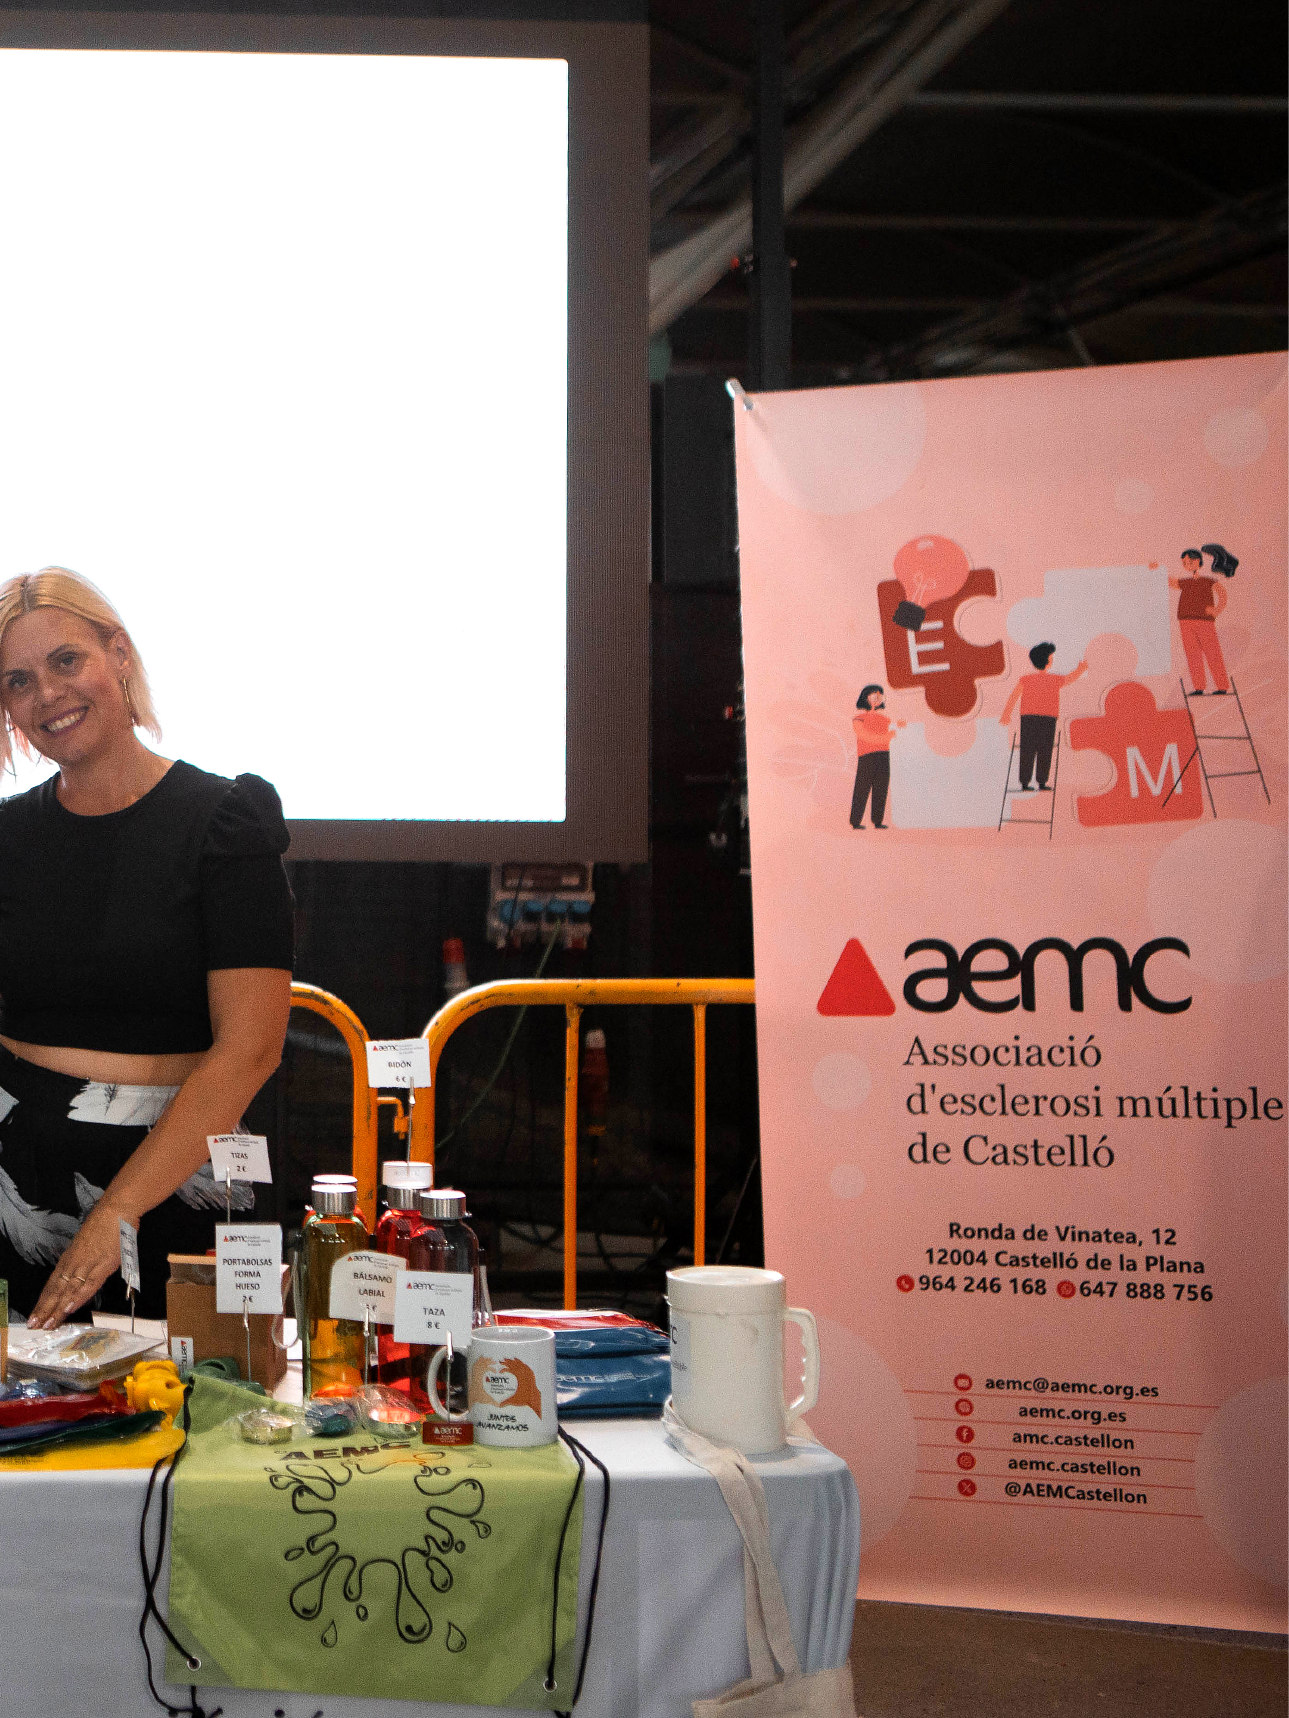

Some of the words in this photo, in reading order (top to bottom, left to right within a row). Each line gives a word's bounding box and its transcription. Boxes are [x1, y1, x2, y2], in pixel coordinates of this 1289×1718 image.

[907, 619, 951, 676] E
[1125, 742, 1184, 800] M
[903, 936, 1193, 1015] aemc
[903, 1034, 1103, 1068] Associació
[387, 1060, 412, 1069] BIDÓN
[906, 1083, 1105, 1118] d'esclerosi
[1117, 1085, 1285, 1129] múltiple
[230, 1152, 248, 1160] TIZAS
[907, 1132, 952, 1166] de
[963, 1133, 1116, 1169] Castelló
[949, 1222, 1016, 1242] Ronda
[1022, 1223, 1049, 1242] de
[1055, 1225, 1144, 1248] Vinatea,
[1151, 1228, 1177, 1246] 12
[222, 1257, 273, 1267] PORTABOLSAS
[925, 1248, 988, 1267] 12004
[994, 1250, 1079, 1271] Castelló
[1085, 1253, 1113, 1272] de
[1119, 1254, 1138, 1273] la
[1145, 1256, 1206, 1275] Plana
[234, 1269, 262, 1279] FORMA
[353, 1270, 393, 1284] BÁLSAMO
[235, 1282, 261, 1291] HUESO
[358, 1288, 386, 1298] LABIAL
[919, 1274, 957, 1293] 964
[963, 1275, 1002, 1295] 246
[1009, 1277, 1047, 1296] 168
[1079, 1280, 1119, 1299] 647
[1126, 1281, 1166, 1301] 888
[1173, 1283, 1214, 1303] 756
[422, 1307, 446, 1317] TAZA
[434, 1321, 441, 1330] €
[985, 1375, 1160, 1400] aemc@aemc.org.es
[486, 1413, 517, 1424] JUNTOS
[1018, 1404, 1128, 1426] aemc.org.es
[477, 1422, 530, 1433] AVANZAMOS
[1012, 1429, 1136, 1451] amc.castellon
[1008, 1456, 1142, 1478] aemc.castellon
[1004, 1481, 1149, 1506] @AEMCastellon
